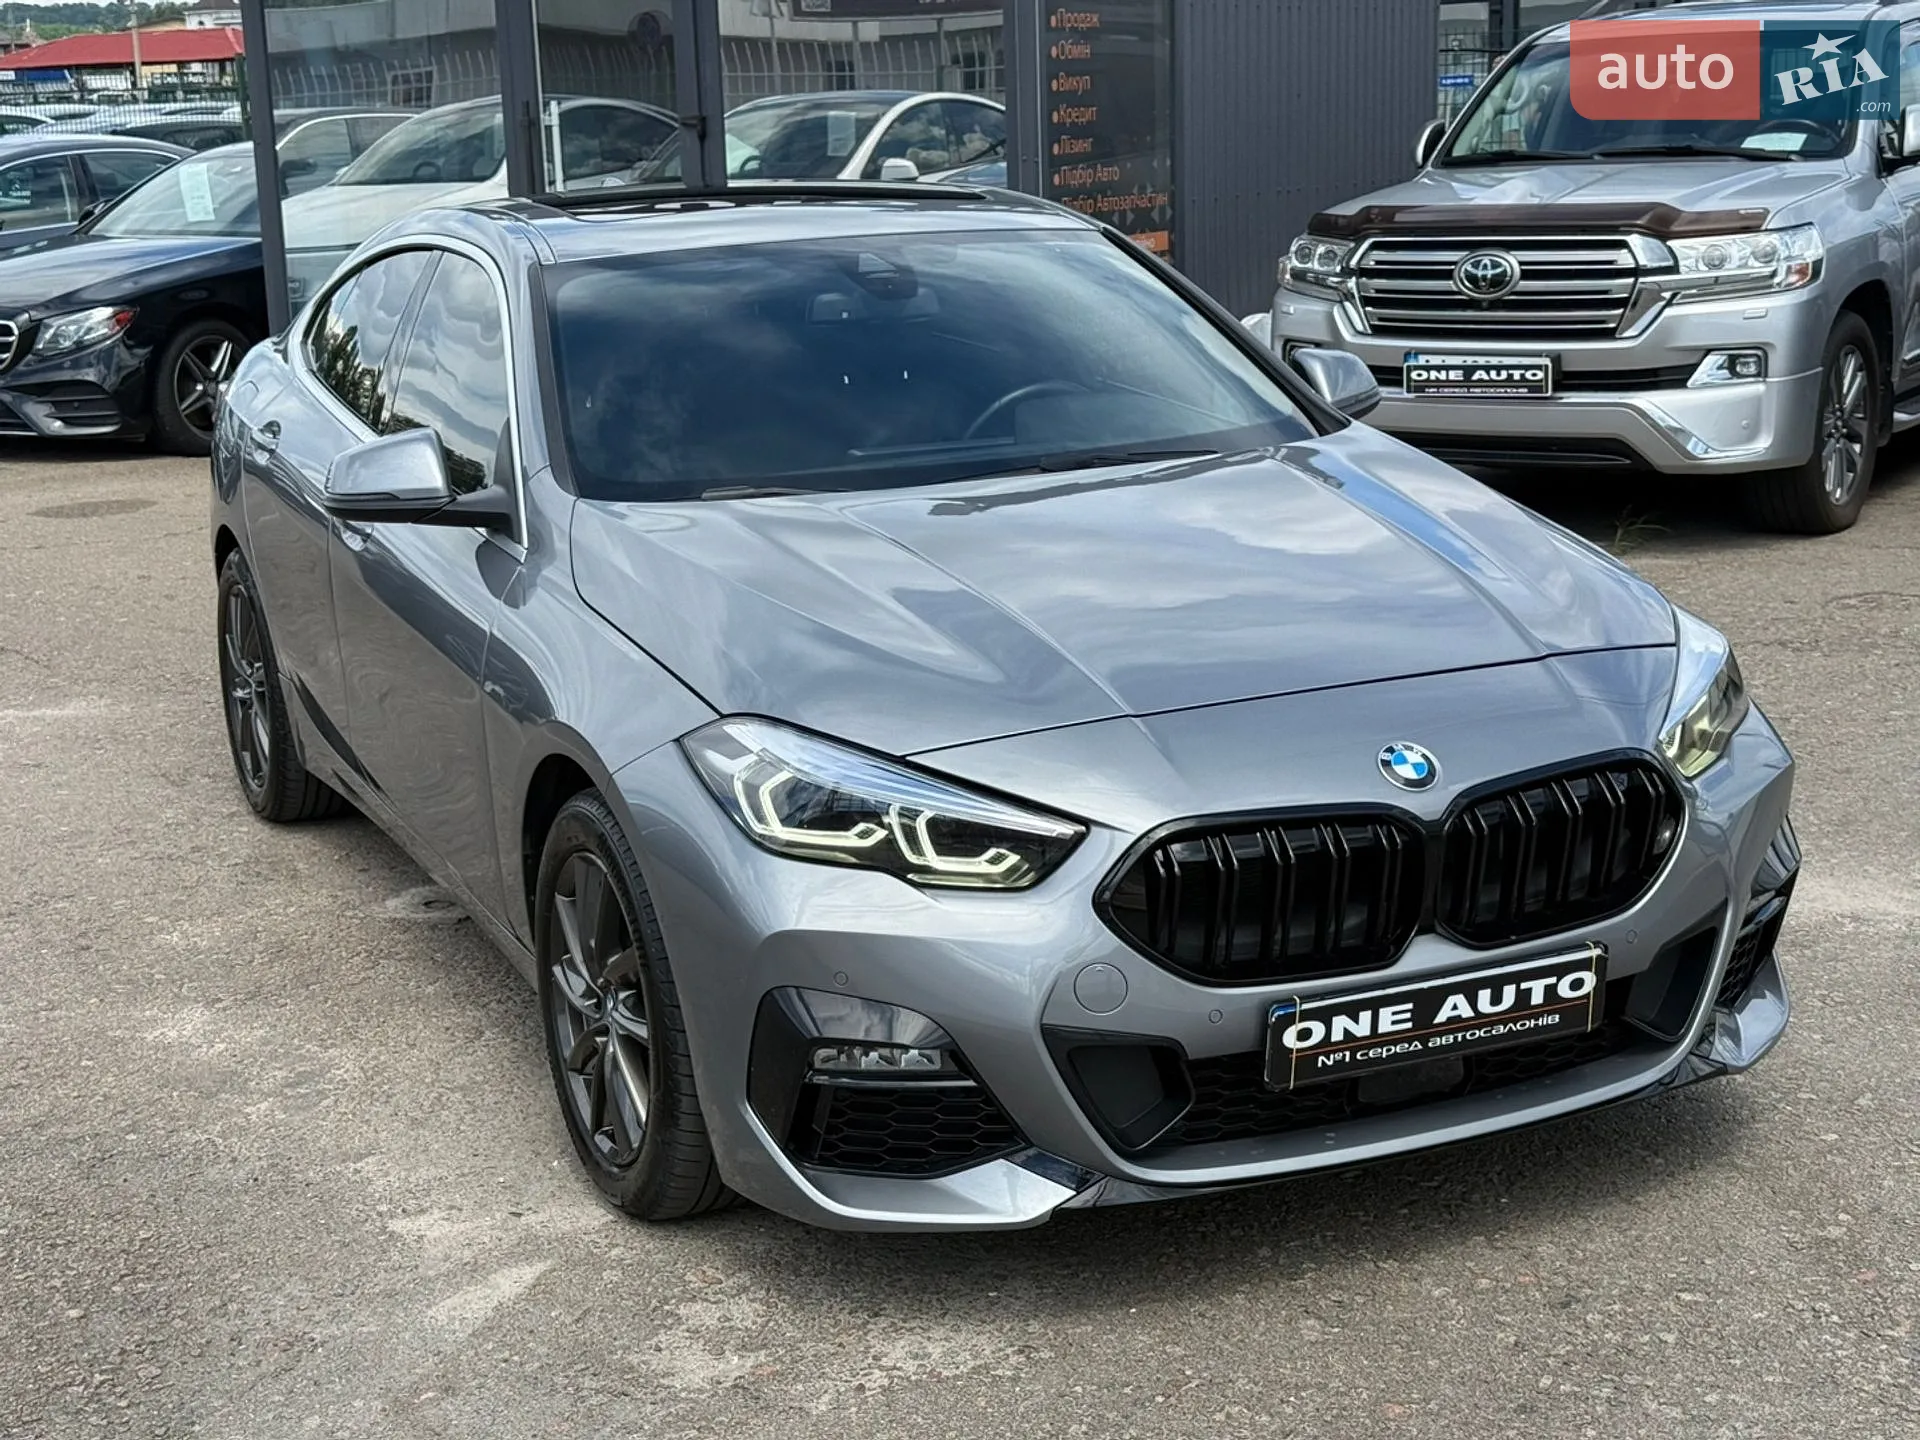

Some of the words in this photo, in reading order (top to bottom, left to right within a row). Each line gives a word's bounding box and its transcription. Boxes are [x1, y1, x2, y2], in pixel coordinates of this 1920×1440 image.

[1057, 9, 1100, 31] Продаж
[1059, 39, 1091, 60] Обмін
[1059, 72, 1091, 96] Викуп
[1059, 104, 1098, 128] Кредит
[1060, 135, 1094, 155] Лізинг
[1060, 164, 1094, 188] Підбір
[1095, 163, 1120, 182] Авто
[1410, 369, 1464, 381] ONE
[1471, 369, 1544, 381] AUTO
[1281, 1003, 1414, 1049] ONE
[1433, 970, 1597, 1024] AUTO
[1317, 1052, 1351, 1068] №1
[1356, 1041, 1423, 1061] серед
[1428, 1013, 1560, 1047] автосалонів
